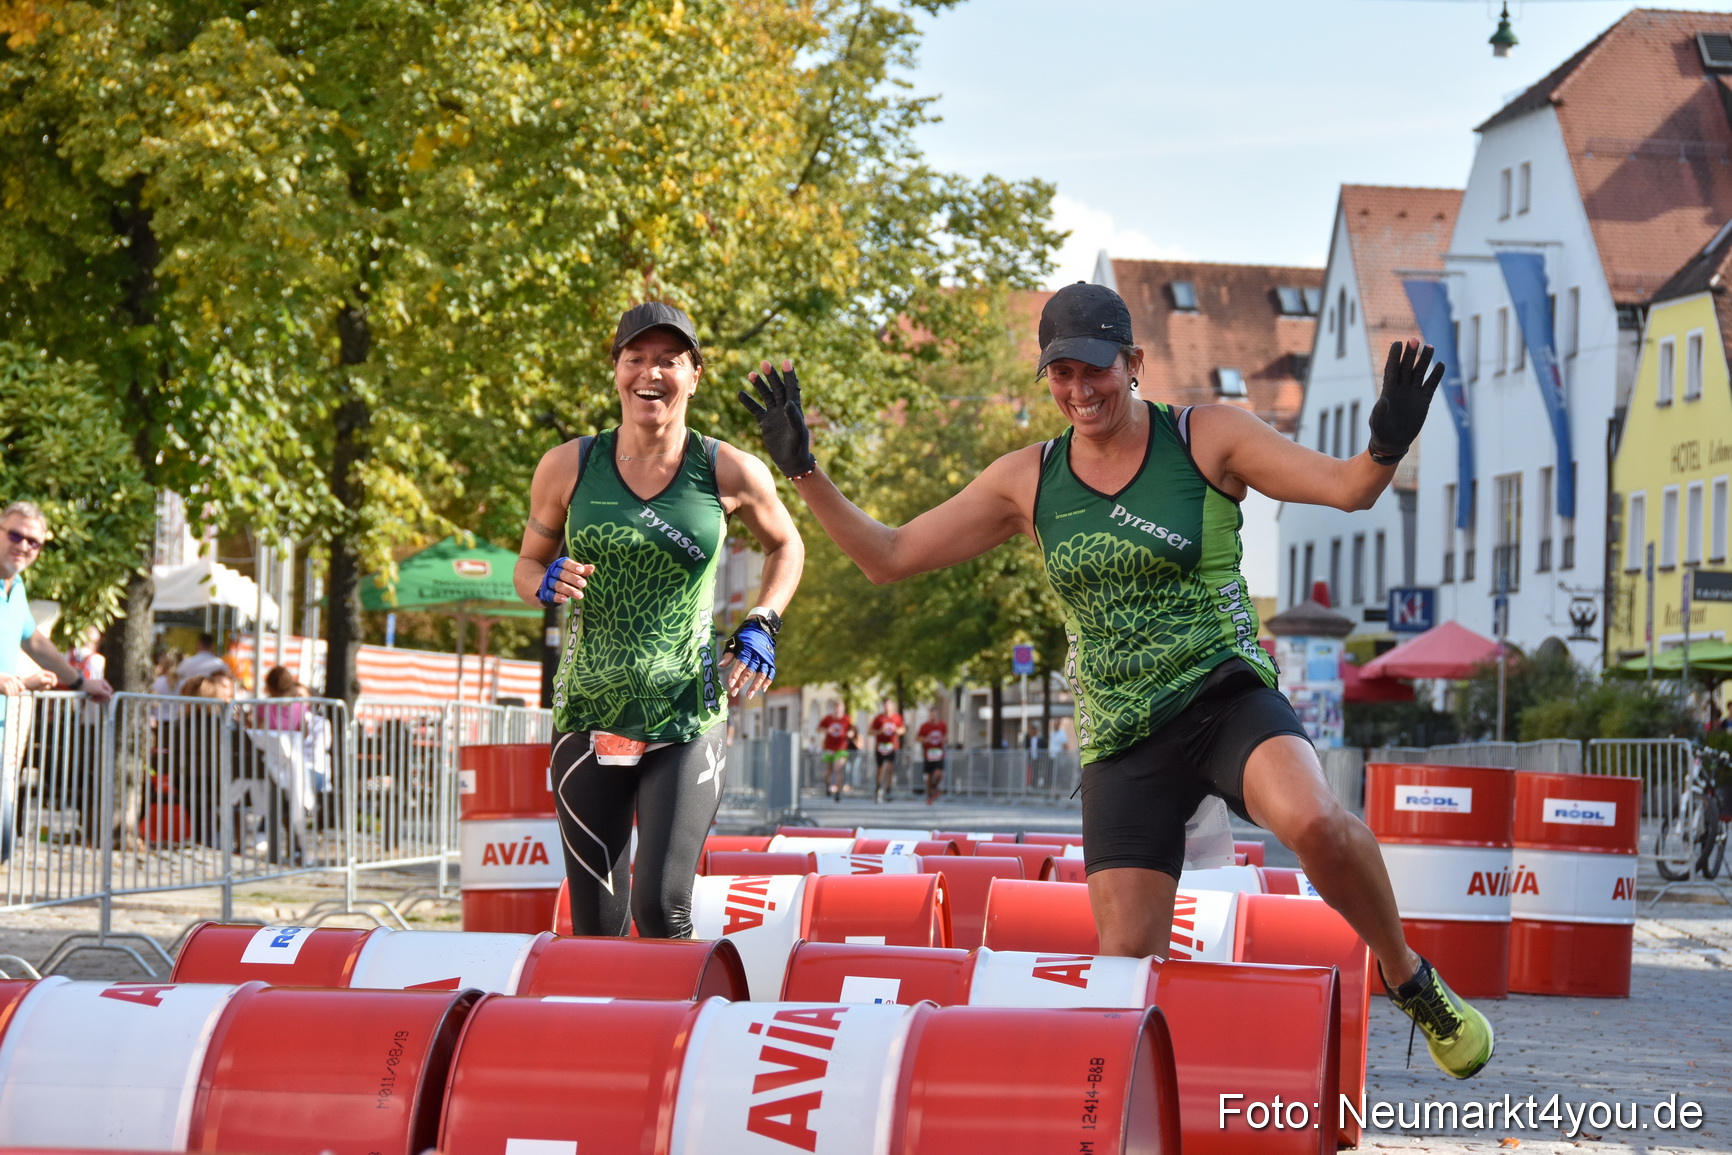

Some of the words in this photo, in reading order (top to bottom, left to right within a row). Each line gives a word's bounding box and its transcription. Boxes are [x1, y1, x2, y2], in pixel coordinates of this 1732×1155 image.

[639, 507, 706, 561] Pyraser
[1109, 503, 1192, 551] Pyraser
[746, 1007, 850, 1153] AVIA
